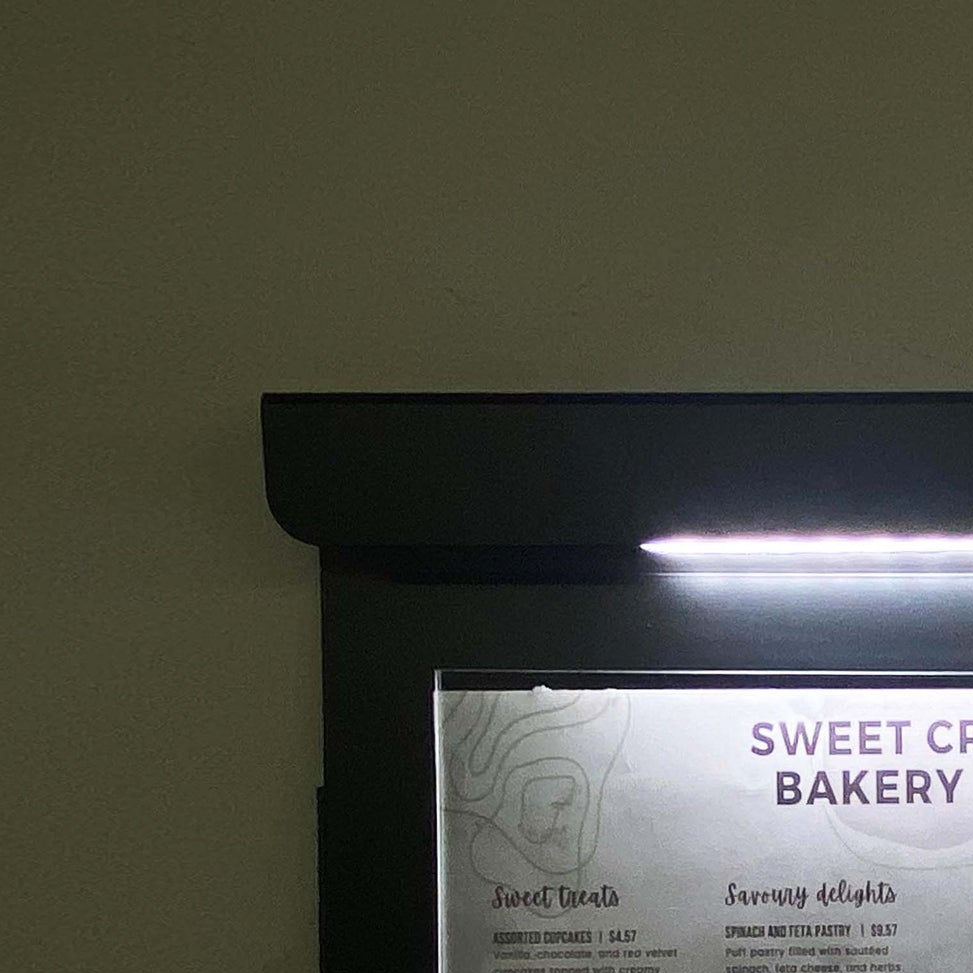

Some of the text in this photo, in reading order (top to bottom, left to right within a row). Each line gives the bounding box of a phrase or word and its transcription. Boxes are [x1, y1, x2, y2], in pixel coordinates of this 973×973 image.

[751, 720, 911, 756] SWEET
[776, 769, 964, 805] BAKERY
[492, 884, 619, 909] Sweet treats
[725, 879, 897, 909] Savoury delights
[493, 930, 636, 944] ASSORTED CUPCAKES $4.57
[725, 925, 765, 938] SPINACH
[768, 925, 786, 938] AND
[815, 924, 851, 937] PASTRY
[599, 949, 678, 958] and red velvet
[726, 946, 841, 958] Puff pastry filled with
